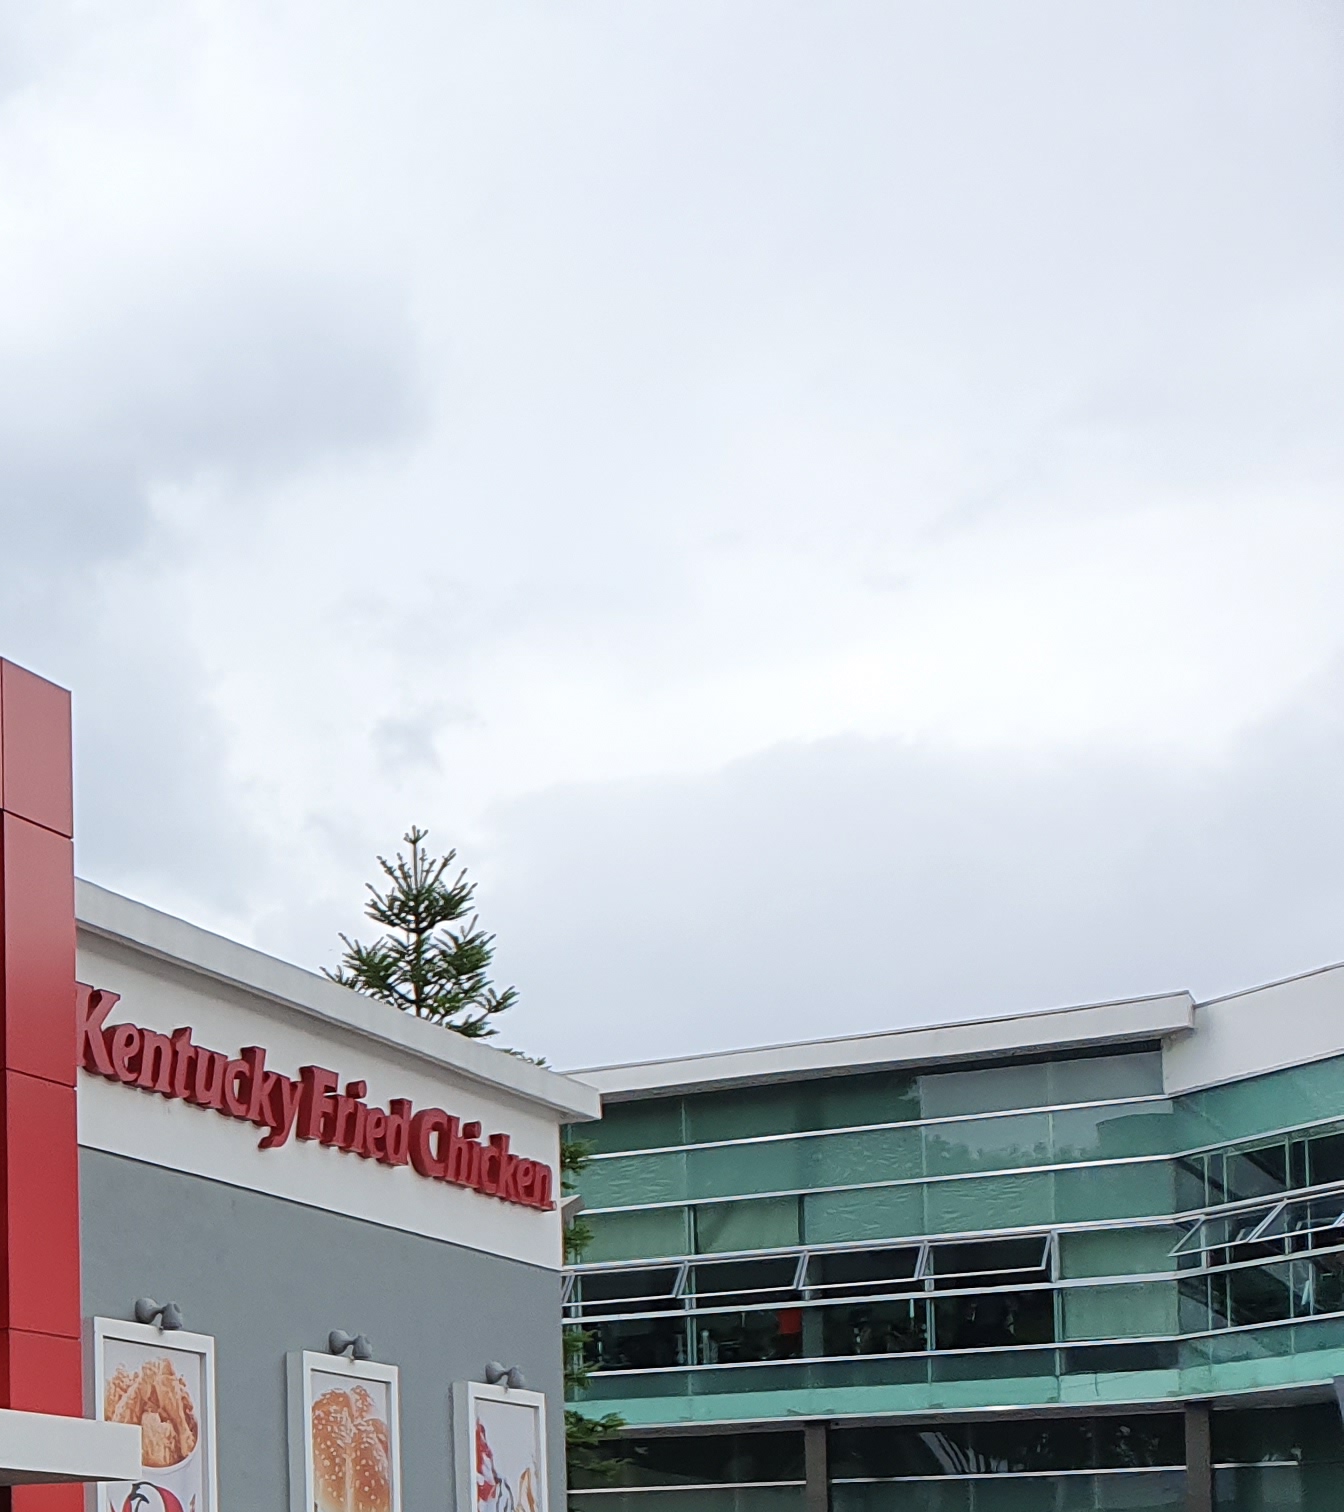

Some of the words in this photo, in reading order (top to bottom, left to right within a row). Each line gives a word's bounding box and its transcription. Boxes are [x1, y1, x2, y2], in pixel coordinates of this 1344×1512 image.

[77, 982, 304, 1150] Kentucky
[297, 1064, 413, 1167] Fried
[412, 1107, 556, 1212] Chicken
